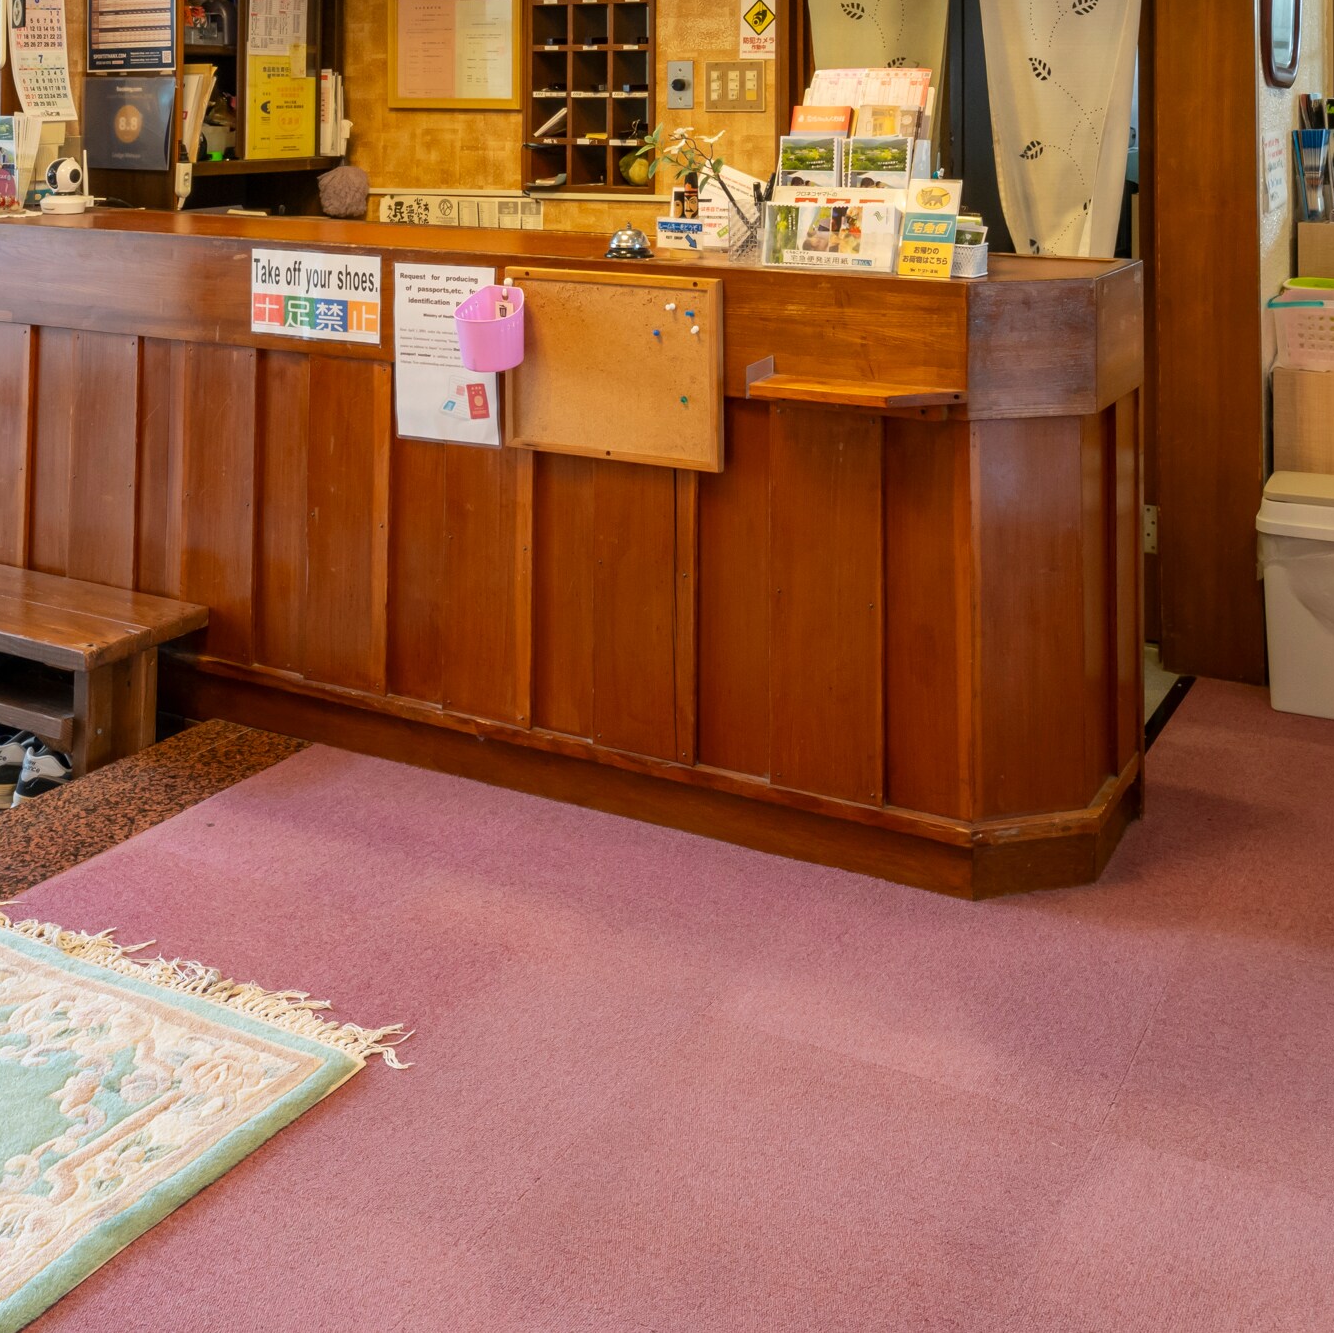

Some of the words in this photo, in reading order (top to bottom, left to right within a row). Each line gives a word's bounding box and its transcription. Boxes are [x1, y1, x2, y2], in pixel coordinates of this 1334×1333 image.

[38, 54, 43, 64] 7
[118, 116, 139, 131] 8.8
[912, 222, 947, 234] 宅急便
[791, 254, 848, 265] 宅急便発送用紙
[902, 256, 948, 265] お荷物はこちら
[253, 258, 280, 285] Take
[286, 261, 302, 286] off
[306, 268, 332, 294] your
[337, 265, 378, 292] shoes.
[400, 272, 426, 280] Request
[445, 276, 479, 284] producing
[417, 286, 463, 294] passports,etc.
[408, 297, 450, 305] identification
[254, 298, 378, 335] 土足禁止
